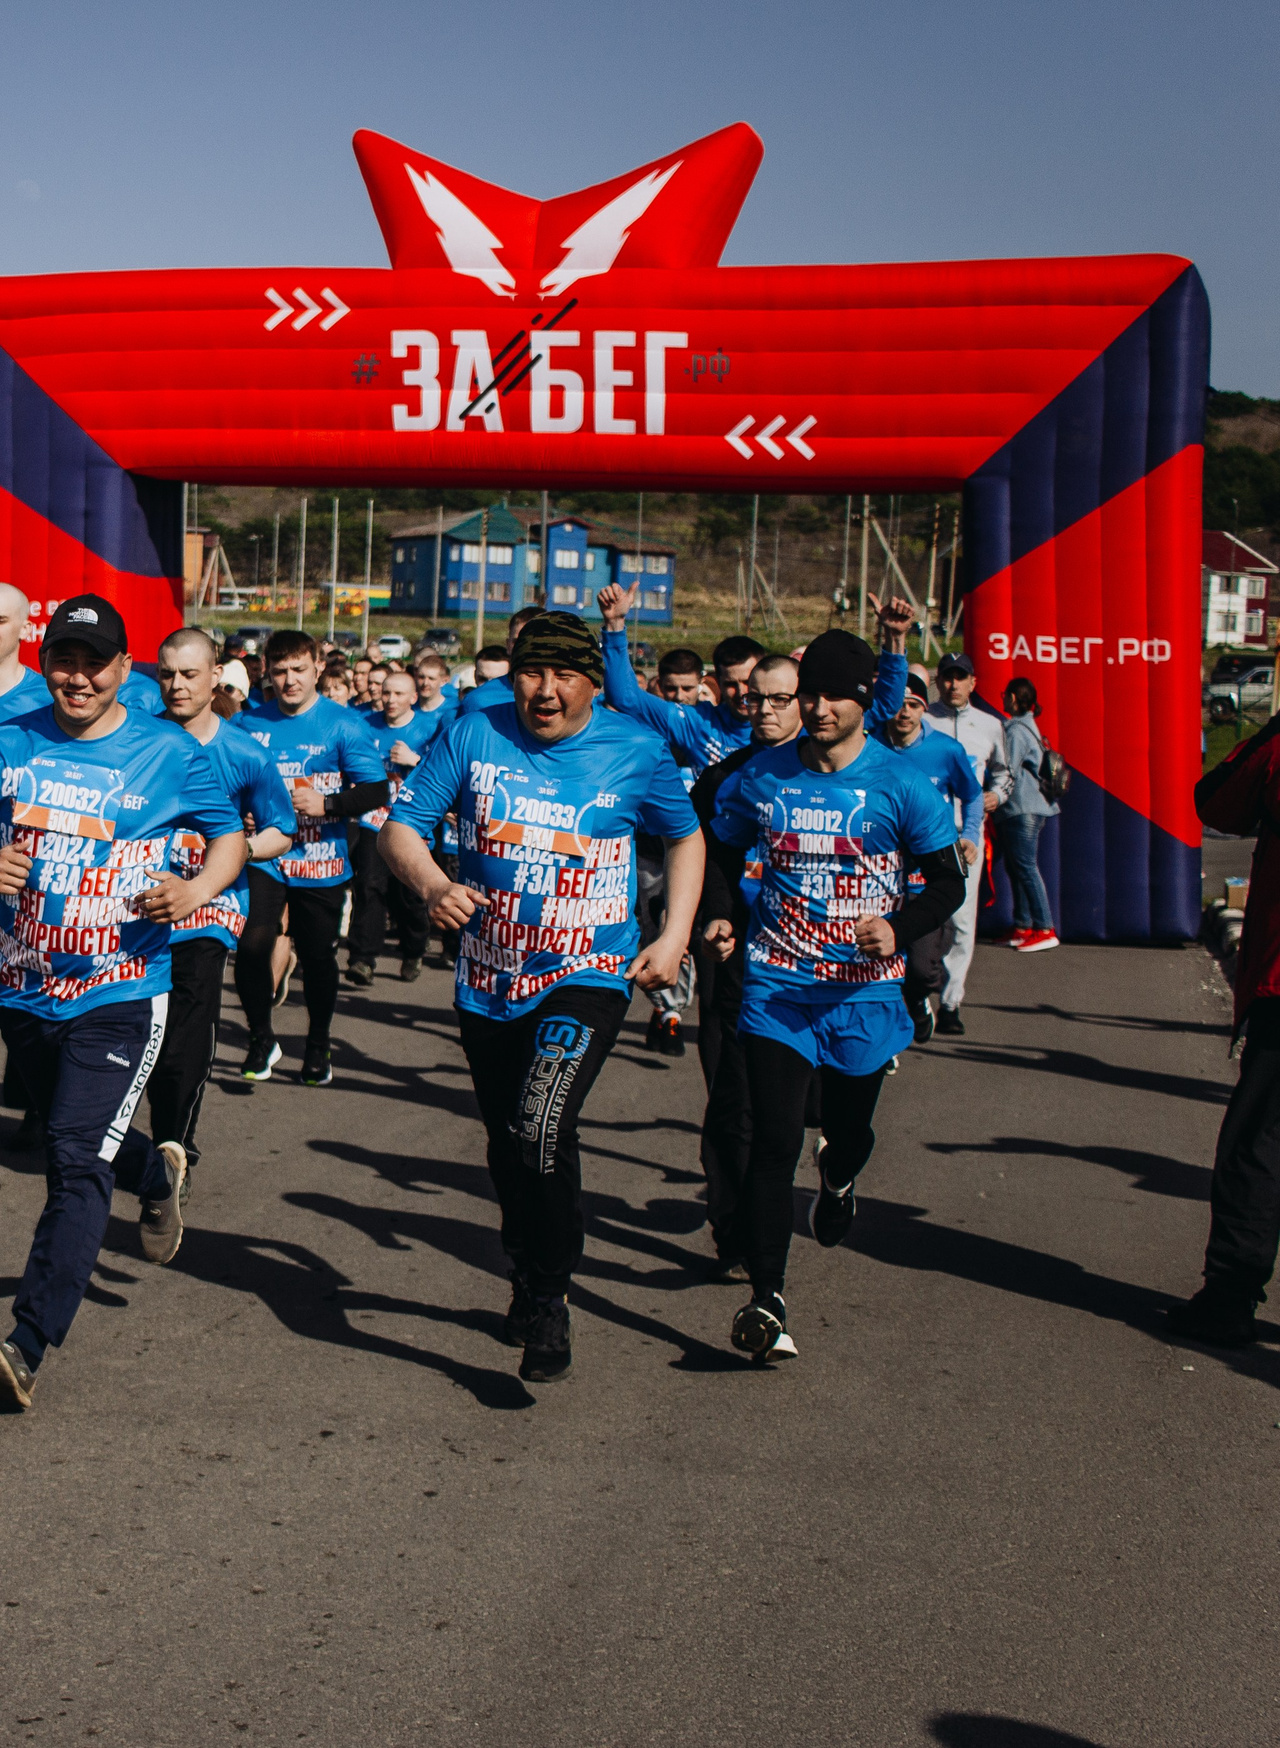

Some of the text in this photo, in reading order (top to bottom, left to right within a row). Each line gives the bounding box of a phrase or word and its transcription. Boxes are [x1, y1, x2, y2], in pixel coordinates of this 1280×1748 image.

[988, 632, 1171, 665] ЗАБЕГ.РФ
[513, 774, 530, 783] ПСБ
[38, 779, 102, 815] 20032
[512, 796, 576, 829] 20033
[790, 807, 844, 833] 30012
[304, 842, 337, 861] 2024
[13, 911, 121, 956] #ГОРДОСТЬ
[478, 912, 596, 956] #ГОРДОСТЬ
[455, 957, 498, 995] АБЕГ
[107, 1052, 131, 1068] Reebok
[130, 1022, 163, 1097] Reebok
